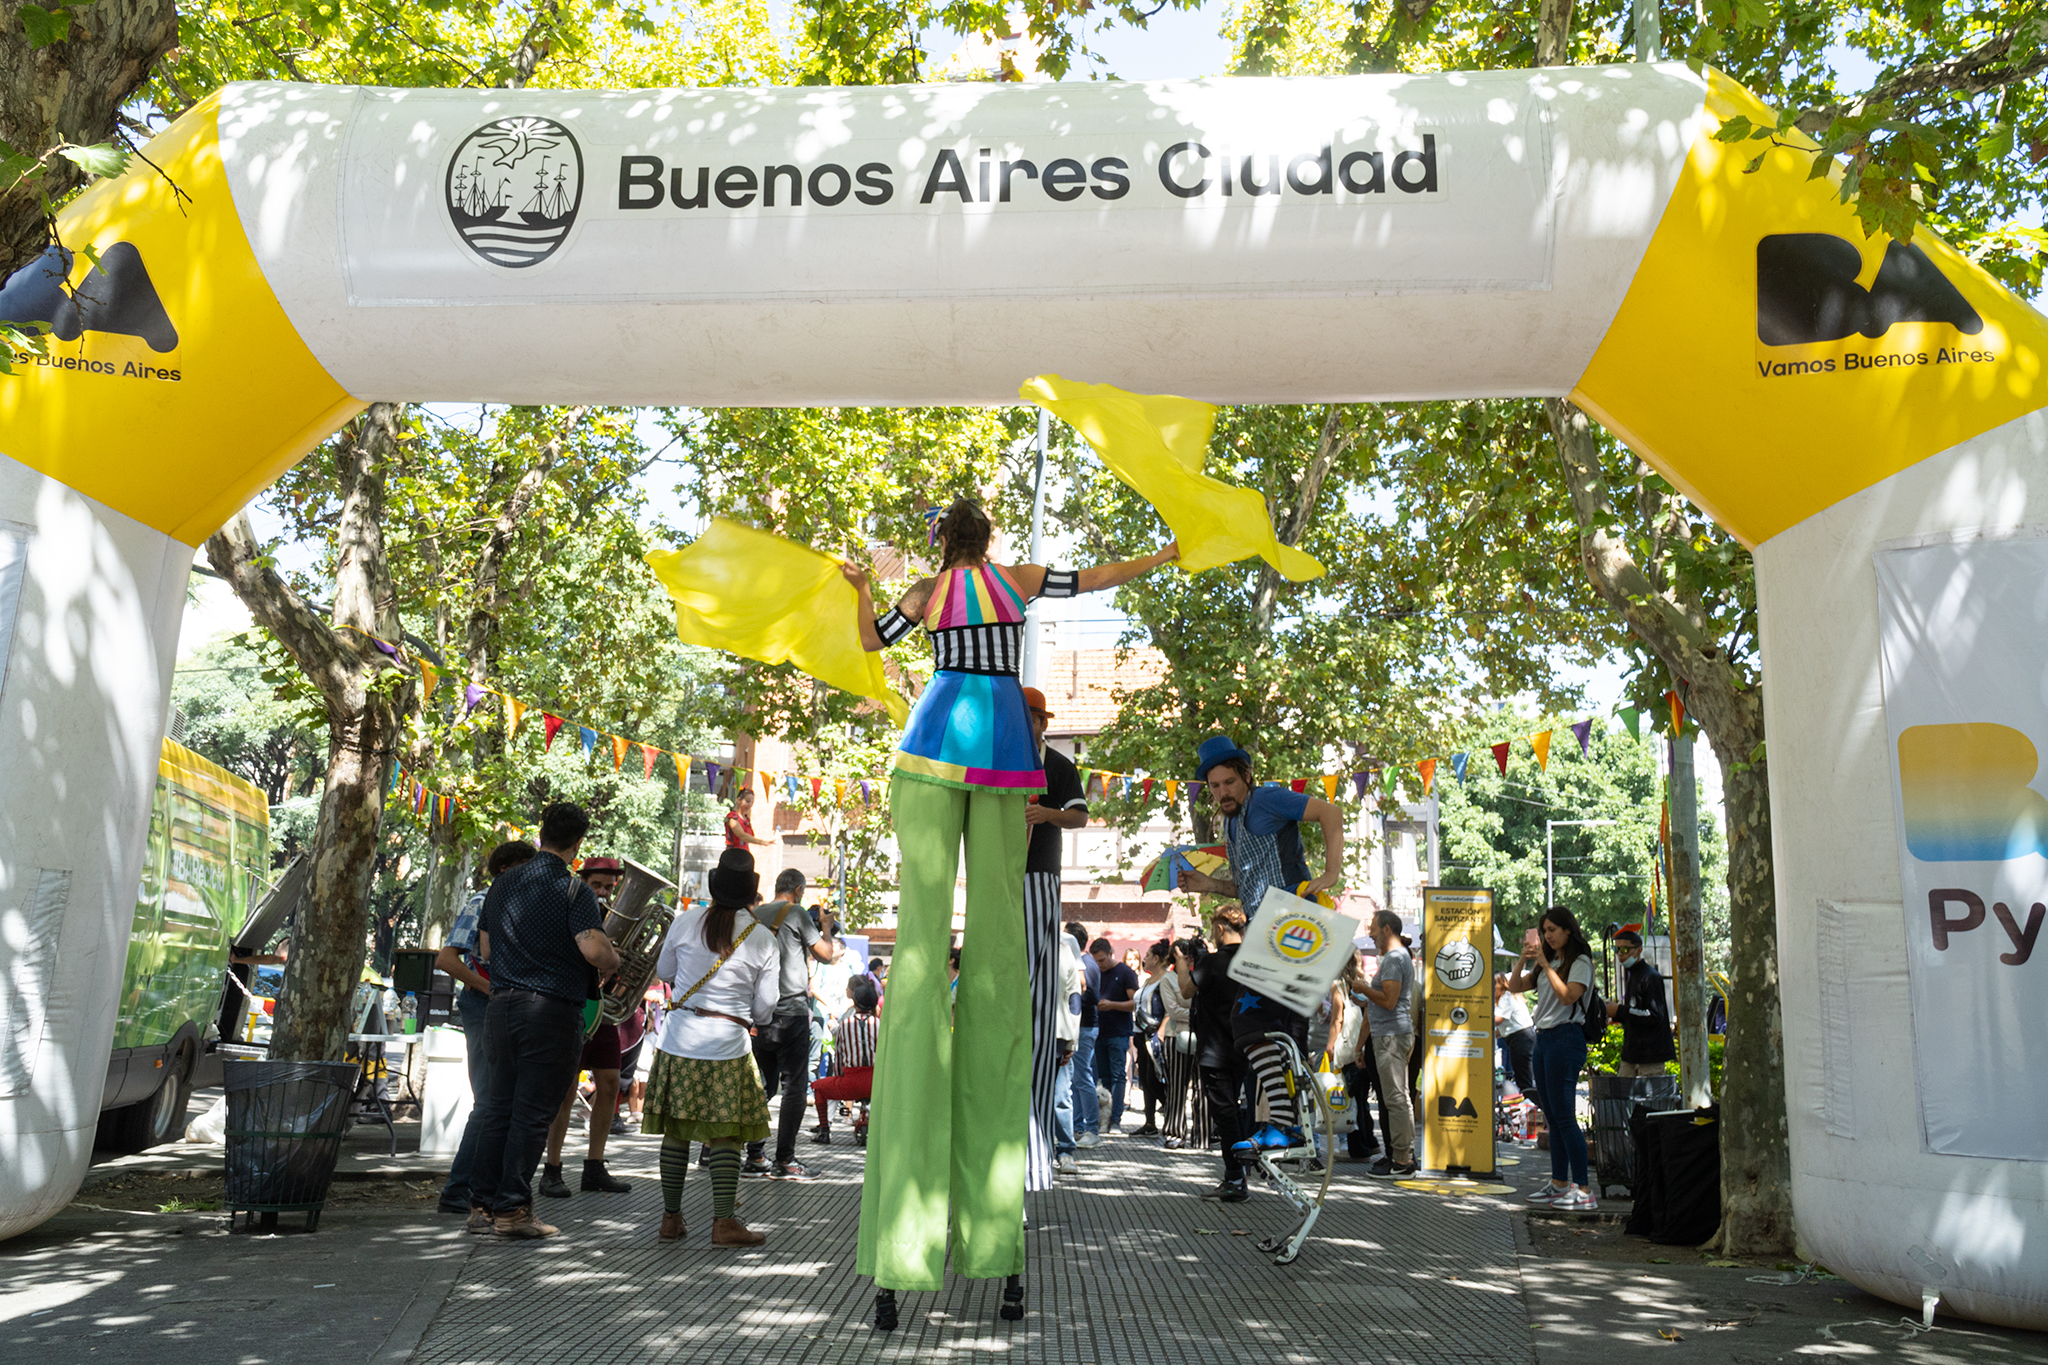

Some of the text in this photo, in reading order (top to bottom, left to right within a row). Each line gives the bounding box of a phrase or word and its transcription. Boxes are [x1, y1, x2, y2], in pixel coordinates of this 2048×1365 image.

[618, 133, 1438, 210] Buenos Aires Ciudad
[122, 361, 182, 381] Aires
[1758, 348, 1995, 377] Vamos Buenos Aires
[1434, 915, 1486, 923] SANITIZANTE
[1440, 907, 1480, 915] ESTACIÓN
[1928, 888, 2047, 966] Py
